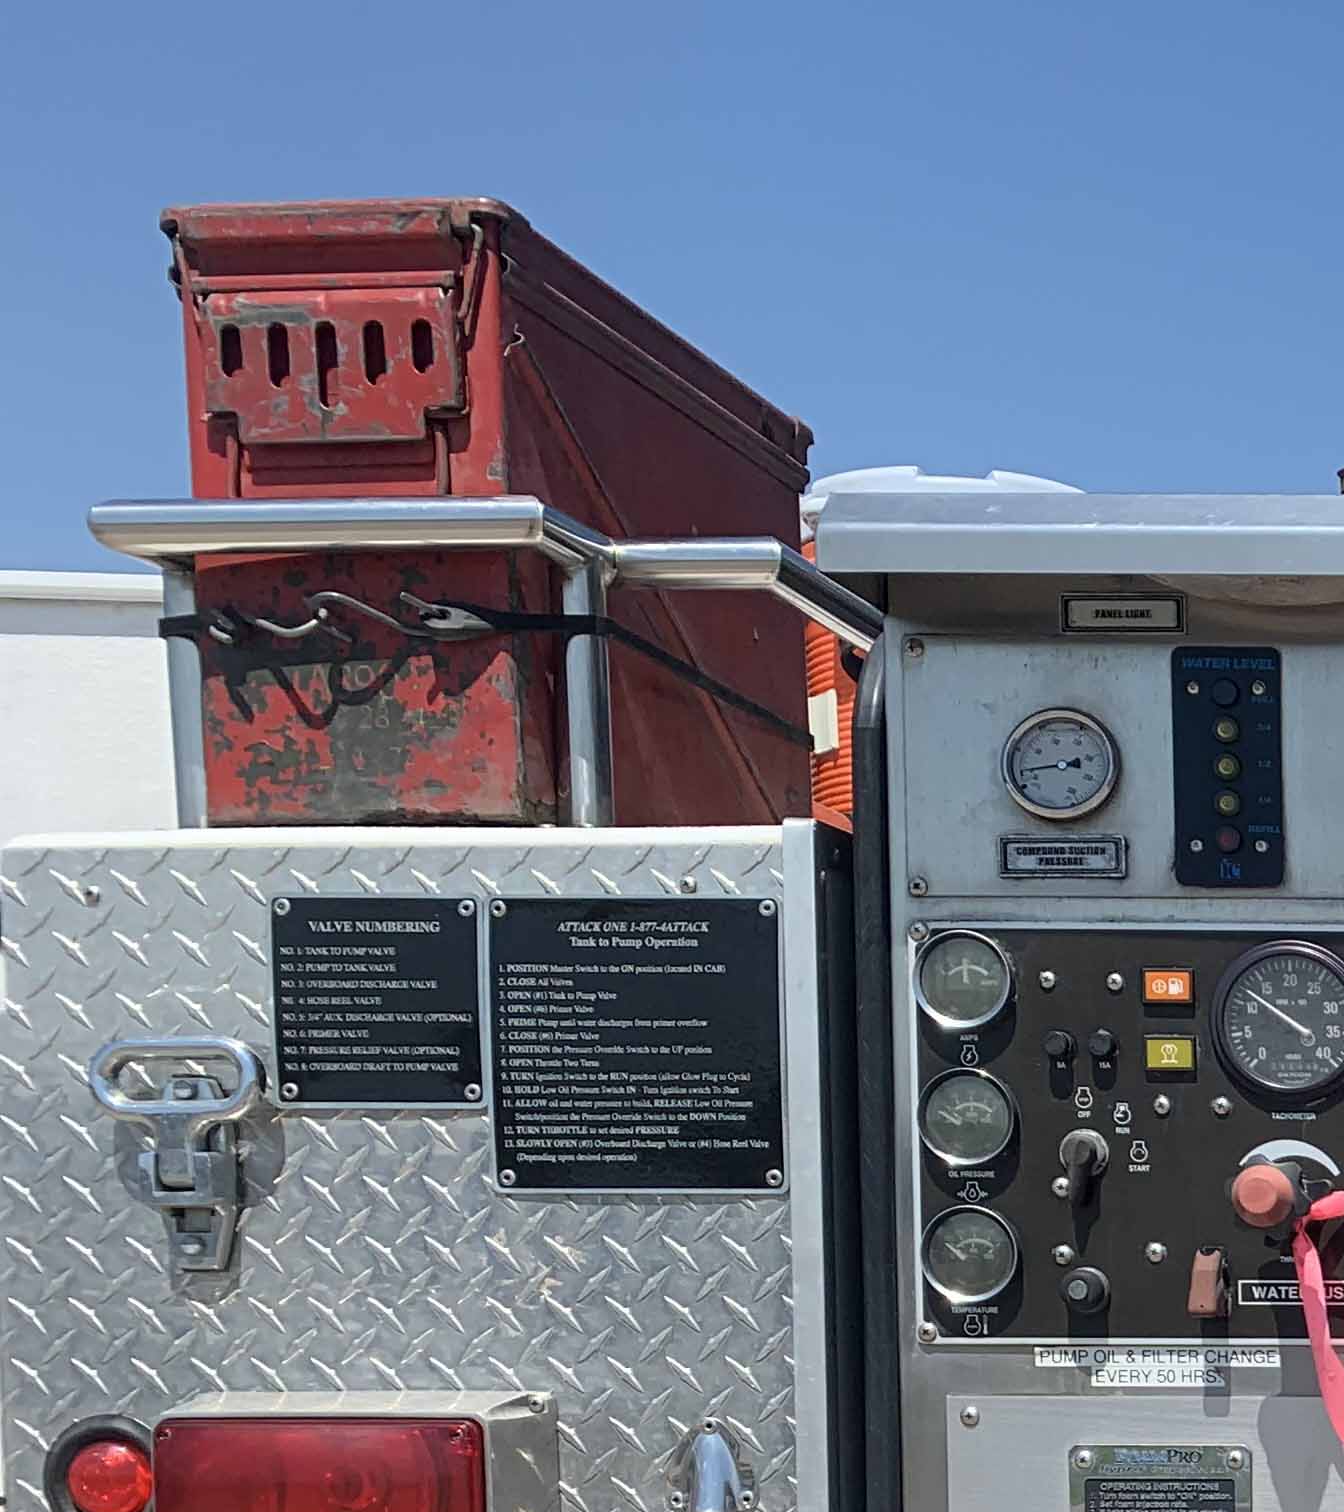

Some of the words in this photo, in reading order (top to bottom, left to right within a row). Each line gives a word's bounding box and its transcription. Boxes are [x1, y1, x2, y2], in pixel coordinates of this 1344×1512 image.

[1183, 657, 1231, 669] WATER
[1233, 658, 1275, 670] LEVEL
[1016, 846, 1067, 856] COMPOUND
[1069, 846, 1106, 856] SUCTION
[308, 921, 352, 932] VALVE
[355, 921, 440, 932] NUMBERING
[557, 922, 601, 933] ATTACK
[602, 922, 628, 933] ONE
[630, 922, 710, 933] 1-877-4ATTACK
[570, 937, 597, 947] Tank
[598, 937, 609, 947] to
[612, 937, 643, 949] Pump
[645, 936, 698, 948] Operation
[1283, 974, 1297, 986] 20
[1261, 982, 1272, 994] 15
[1307, 982, 1322, 994] 25
[1247, 1002, 1258, 1014] 10
[1323, 1002, 1338, 1014] 30
[1244, 1026, 1252, 1038] 5
[1326, 1026, 1340, 1038] 35
[1258, 1047, 1266, 1060] 0
[1315, 1047, 1332, 1060] 40
[1077, 1110, 1092, 1118] OFF
[948, 1170, 959, 1178] OIL
[960, 1170, 995, 1178] PRESSURE
[1128, 1164, 1150, 1172] START
[1251, 1286, 1344, 1300] WATEUS
[951, 1306, 998, 1314] TEMPERATURE
[1040, 1350, 1088, 1364] PUMP
[1094, 1350, 1120, 1364] OIL
[1127, 1350, 1136, 1364] &
[1142, 1350, 1199, 1364] FILTER
[1204, 1350, 1278, 1364] CHANGE
[1096, 1370, 1151, 1383] EVERY
[1157, 1370, 1176, 1383] 50
[1100, 1482, 1151, 1492] OPERATING
[1153, 1482, 1220, 1492] INSTRUCTIONS
